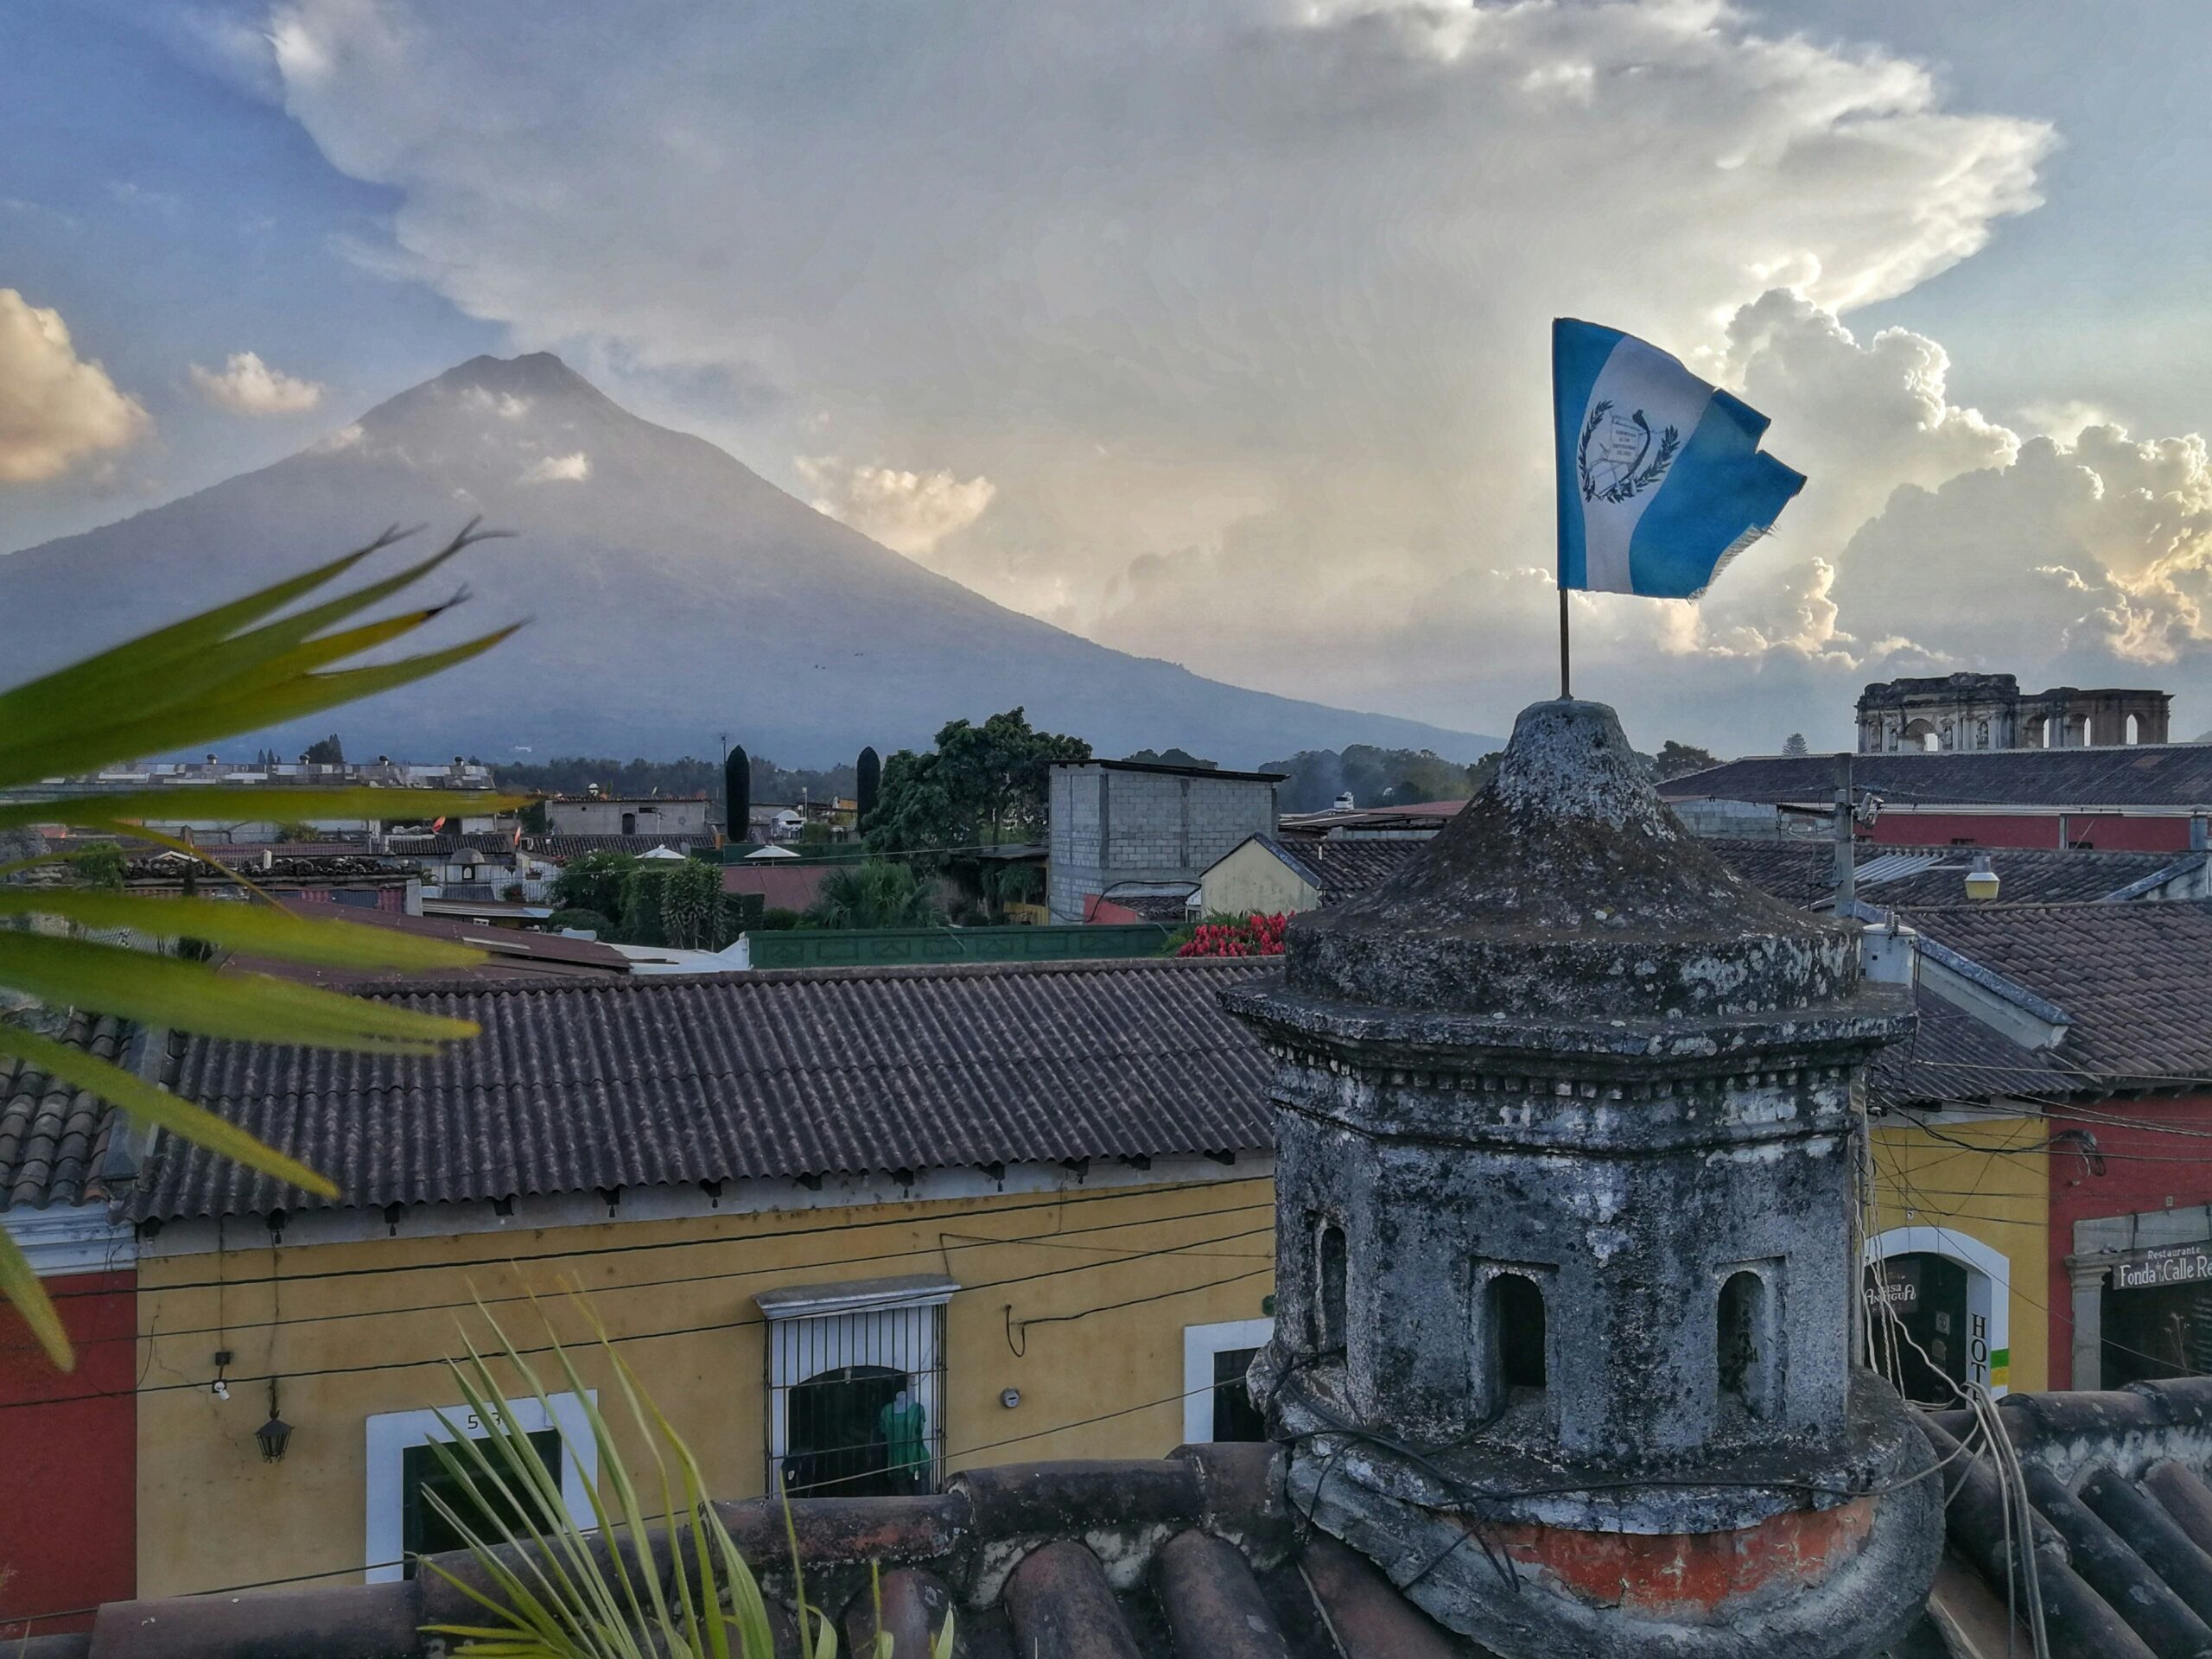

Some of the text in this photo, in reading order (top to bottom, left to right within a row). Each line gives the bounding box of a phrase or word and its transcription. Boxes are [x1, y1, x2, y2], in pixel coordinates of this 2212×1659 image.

[2148, 1247, 2201, 1260] Restaurante
[2120, 1262, 2156, 1287] Fonda
[2164, 1257, 2195, 1281] Calle
